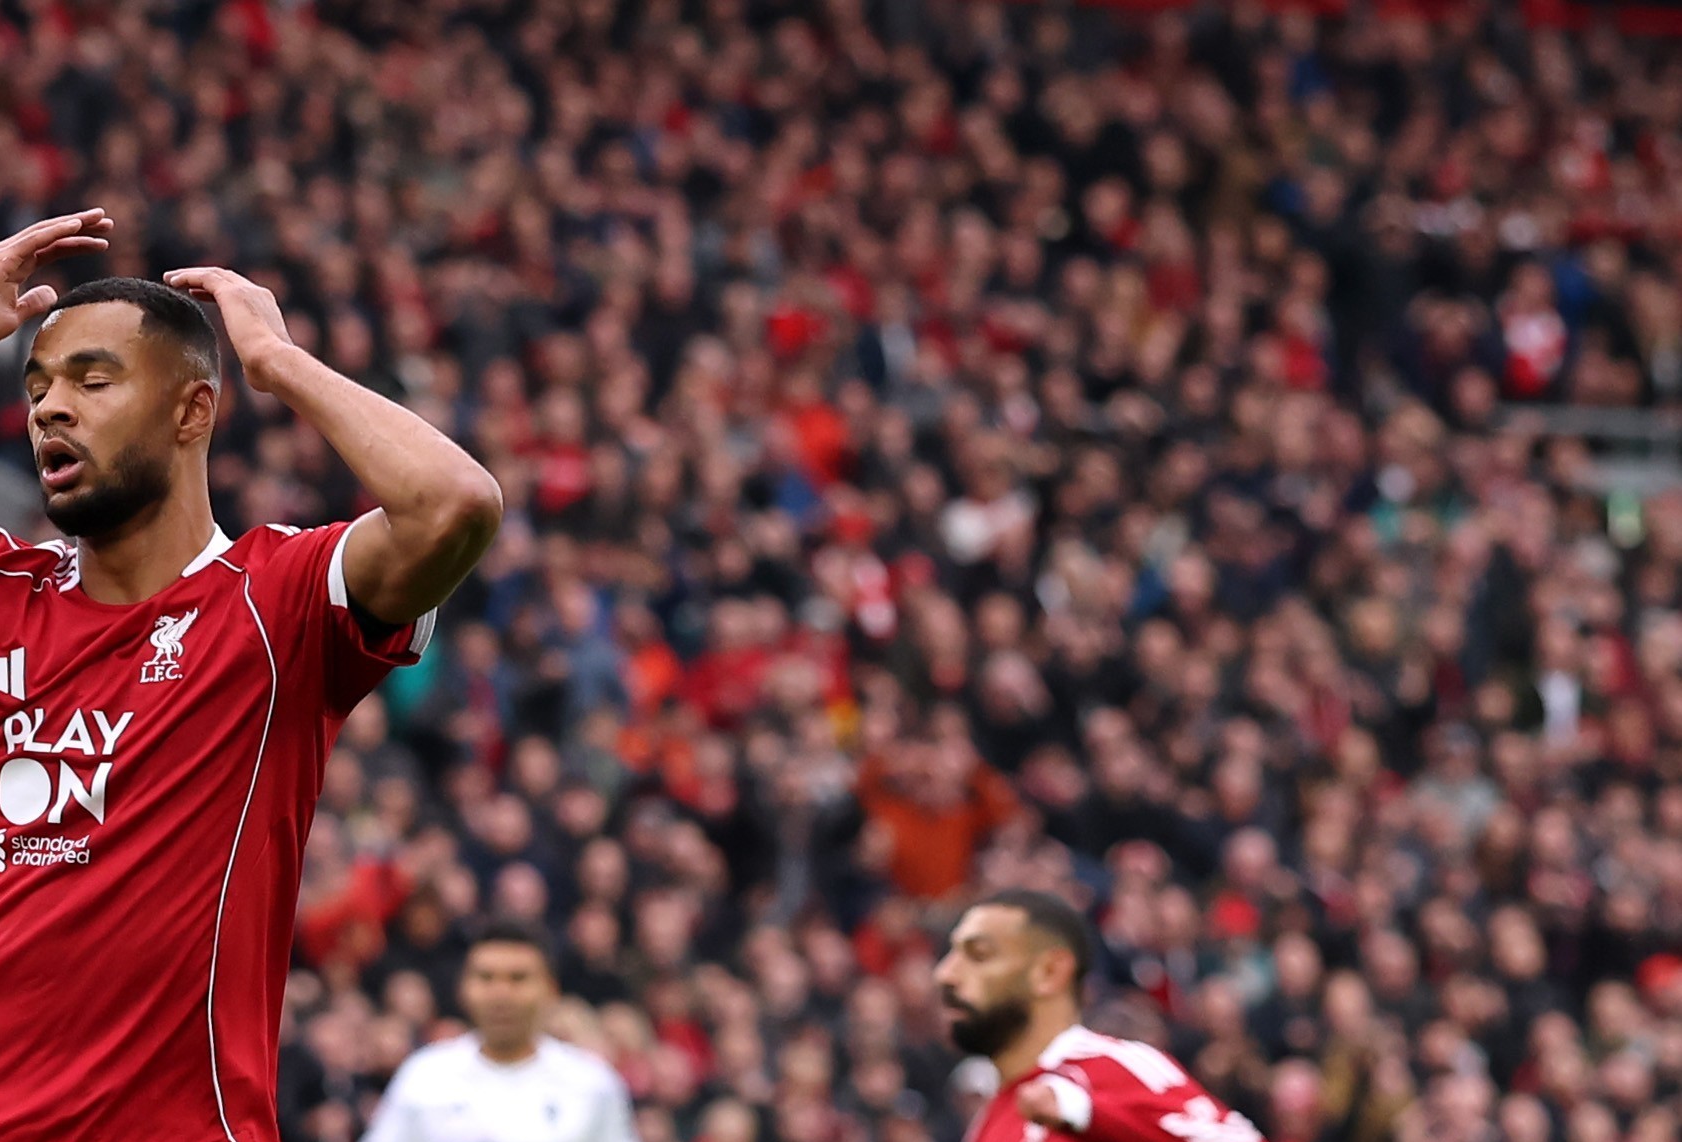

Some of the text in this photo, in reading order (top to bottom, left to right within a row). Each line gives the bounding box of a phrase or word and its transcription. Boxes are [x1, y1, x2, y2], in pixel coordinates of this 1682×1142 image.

[140, 664, 183, 683] L.F.C.
[3, 708, 134, 755] PLAY
[11, 834, 90, 852] standad
